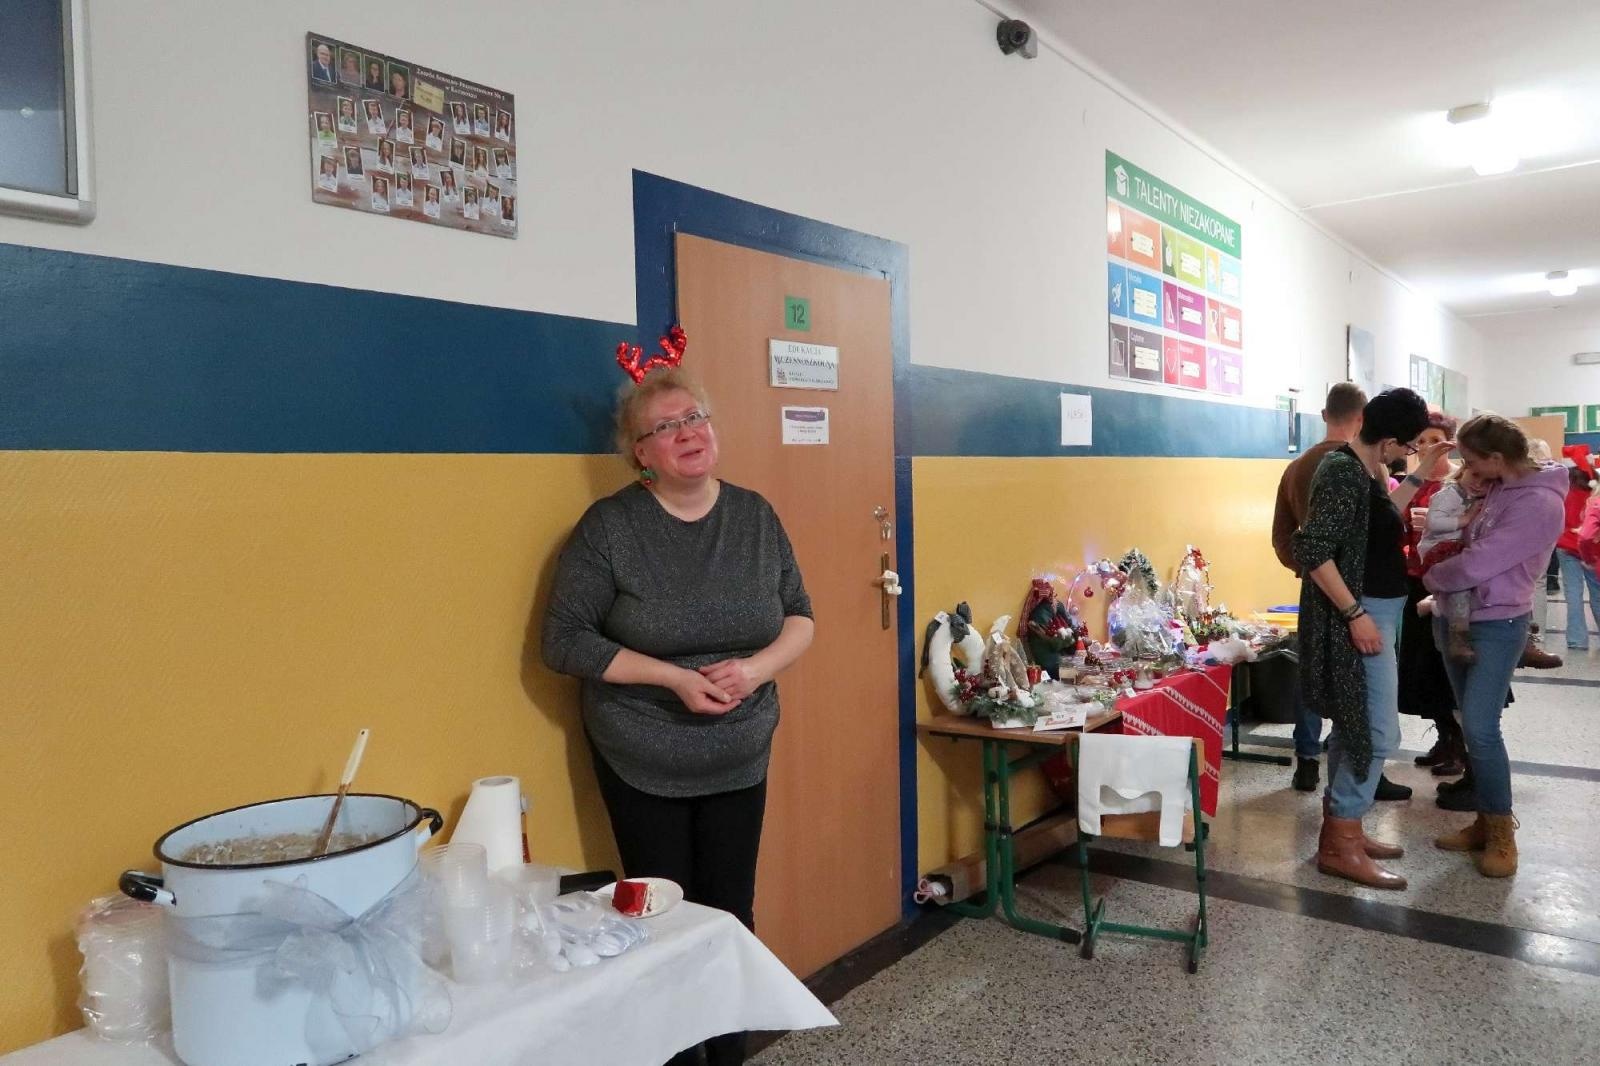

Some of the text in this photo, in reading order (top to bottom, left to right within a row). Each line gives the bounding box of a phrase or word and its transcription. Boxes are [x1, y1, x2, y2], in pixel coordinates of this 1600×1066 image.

[1134, 177, 1179, 218] TALENTY
[1180, 202, 1235, 248] NIEZAKOPANE
[790, 303, 805, 324] 12
